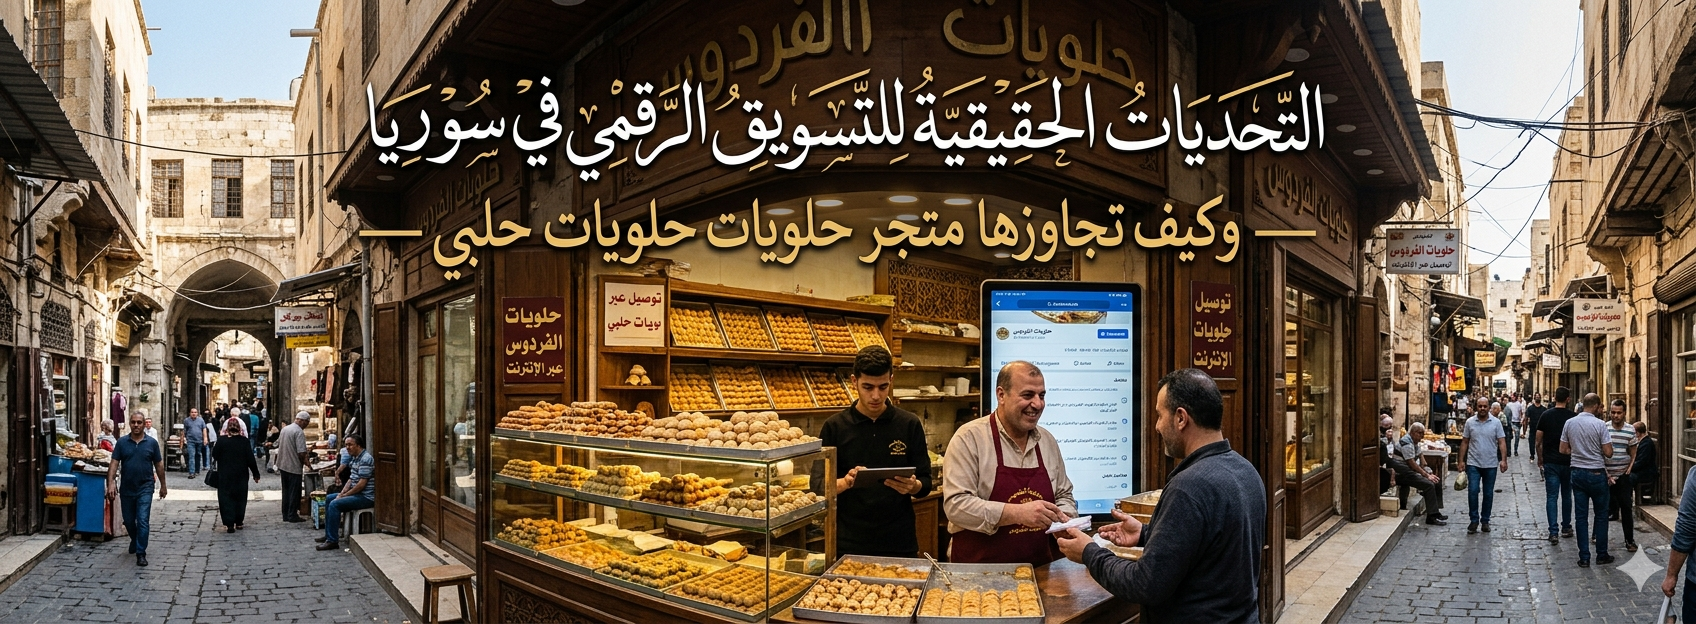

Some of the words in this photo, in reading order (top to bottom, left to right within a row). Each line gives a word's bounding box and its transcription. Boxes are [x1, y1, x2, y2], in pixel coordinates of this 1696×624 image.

[942, 0, 1137, 91] حلويات
[1268, 164, 1318, 217] الفردوس
[1318, 194, 1350, 244] حلويات
[628, 292, 662, 306] توصيل
[505, 307, 562, 329] حلويات
[607, 316, 632, 332] حلبي
[505, 333, 563, 356] الفردوس
[506, 362, 545, 376] الإنترنت
[546, 363, 563, 376] عبر
